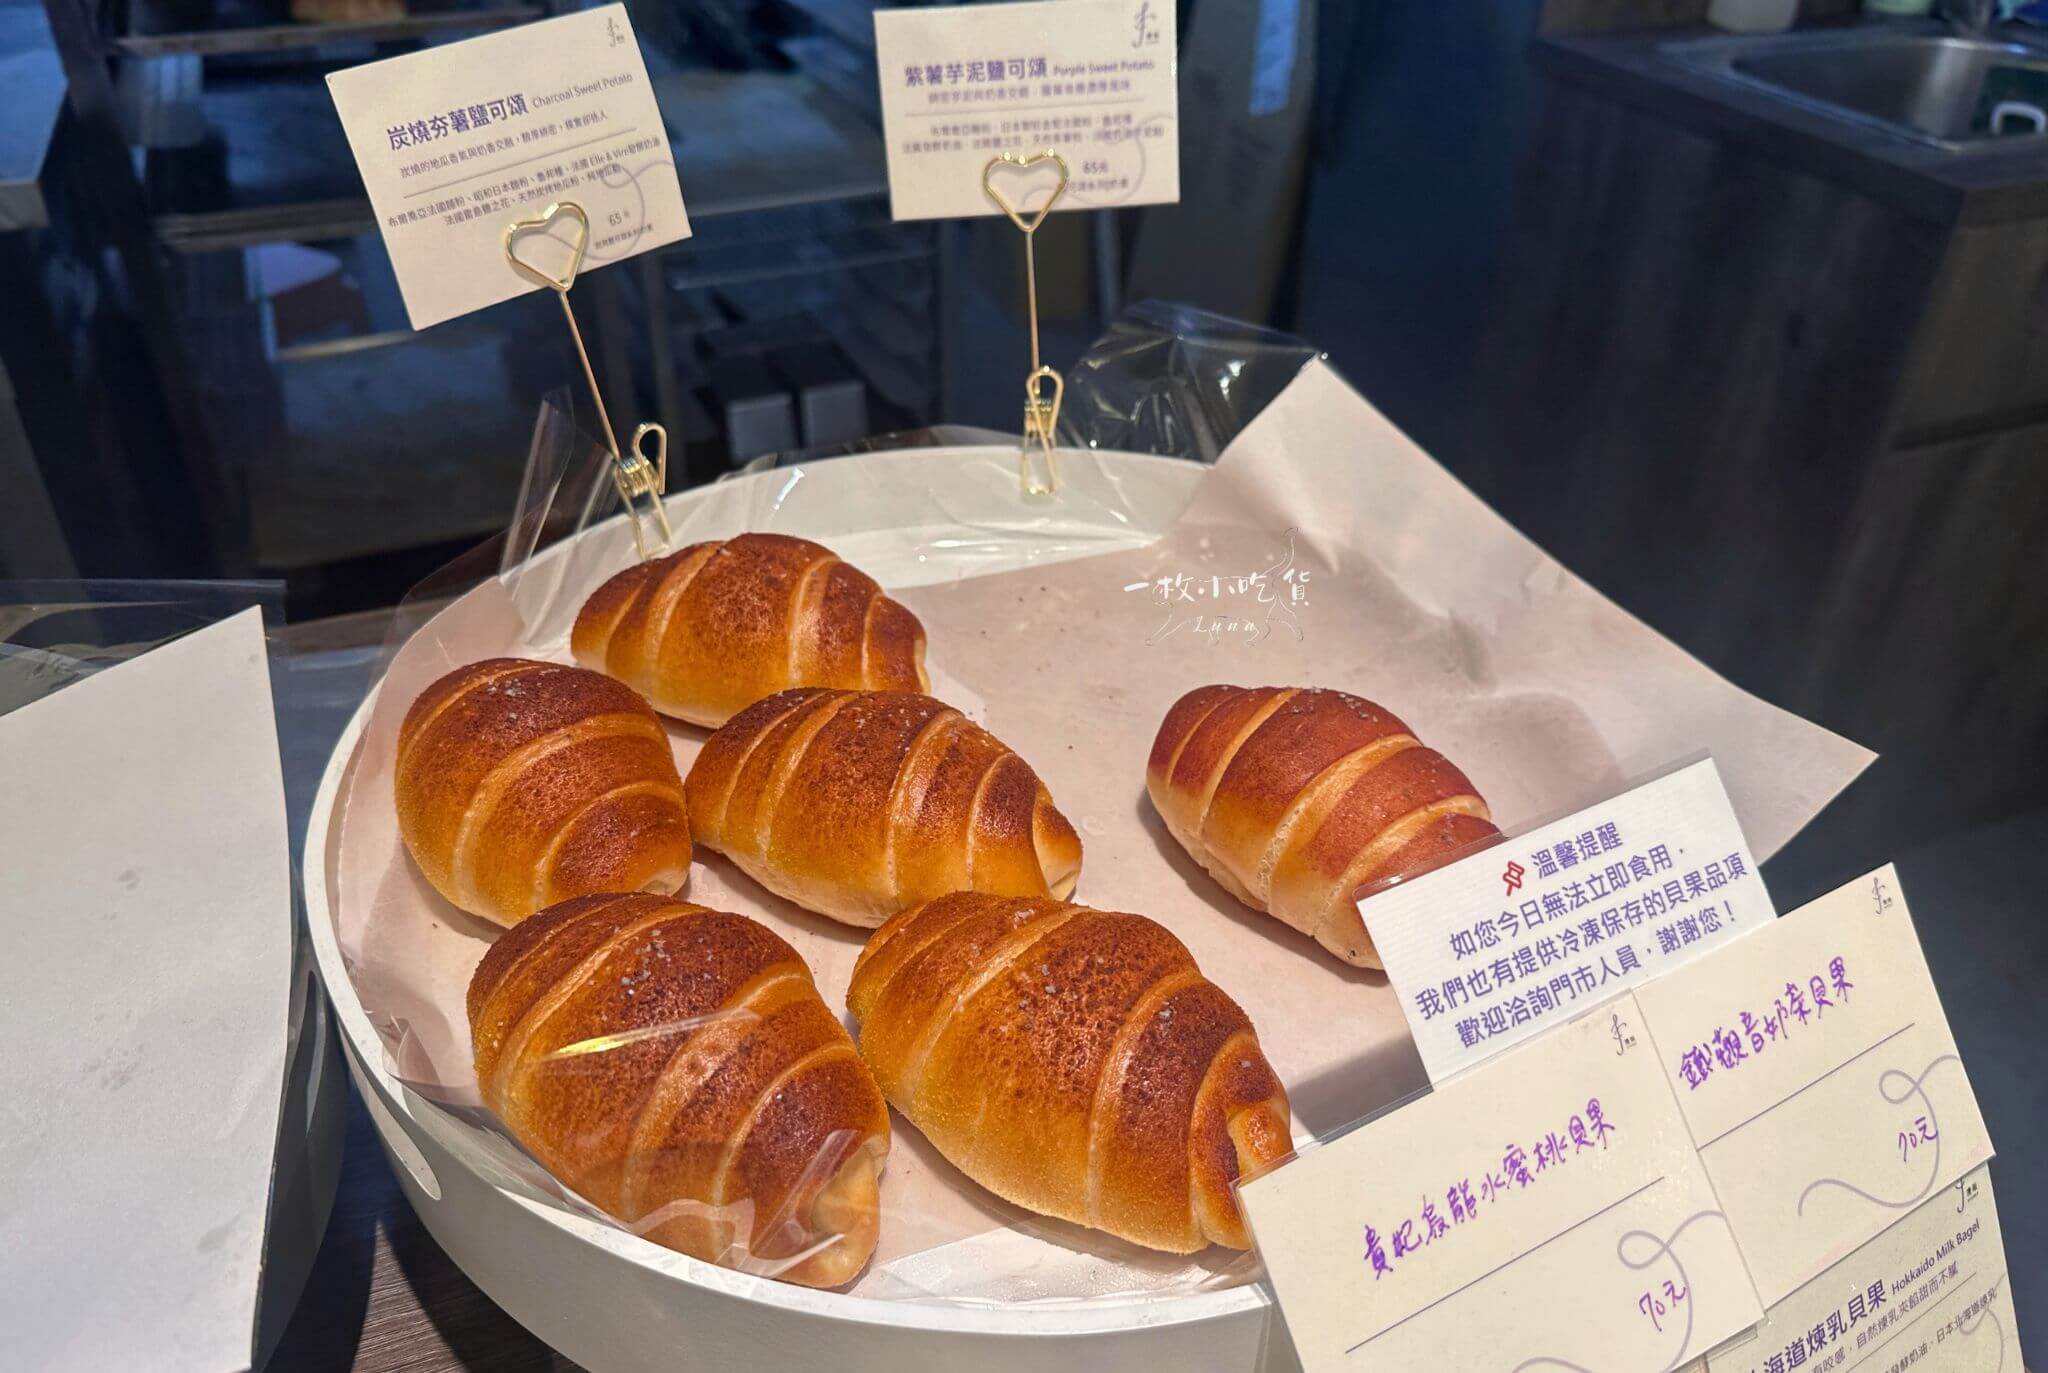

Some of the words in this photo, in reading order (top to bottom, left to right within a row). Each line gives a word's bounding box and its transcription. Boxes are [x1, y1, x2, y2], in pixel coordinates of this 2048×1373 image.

[532, 88, 574, 109] Charcoal
[574, 80, 602, 97] Sweet
[602, 73, 633, 89] Potato
[904, 57, 1048, 87] 紫薯芋泥鹽可頌
[387, 94, 529, 151] 炭燒夯薯鹽可頌
[1531, 821, 1625, 880] 溫馨提醒
[1415, 852, 1748, 1021] 我們也有提供冷凍保存的貝果品項
[1898, 1116, 1938, 1162] 70元
[1362, 1097, 1616, 1280] 貴妃烏龍水蜜桃貝果
[1891, 1256, 1935, 1295] Hokkaido
[1936, 1239, 1956, 1261] Milk
[1956, 1217, 1980, 1246] Bagel
[1638, 1278, 1688, 1332] 70元
[1751, 1279, 1887, 1373] 海道煉乳貝果
